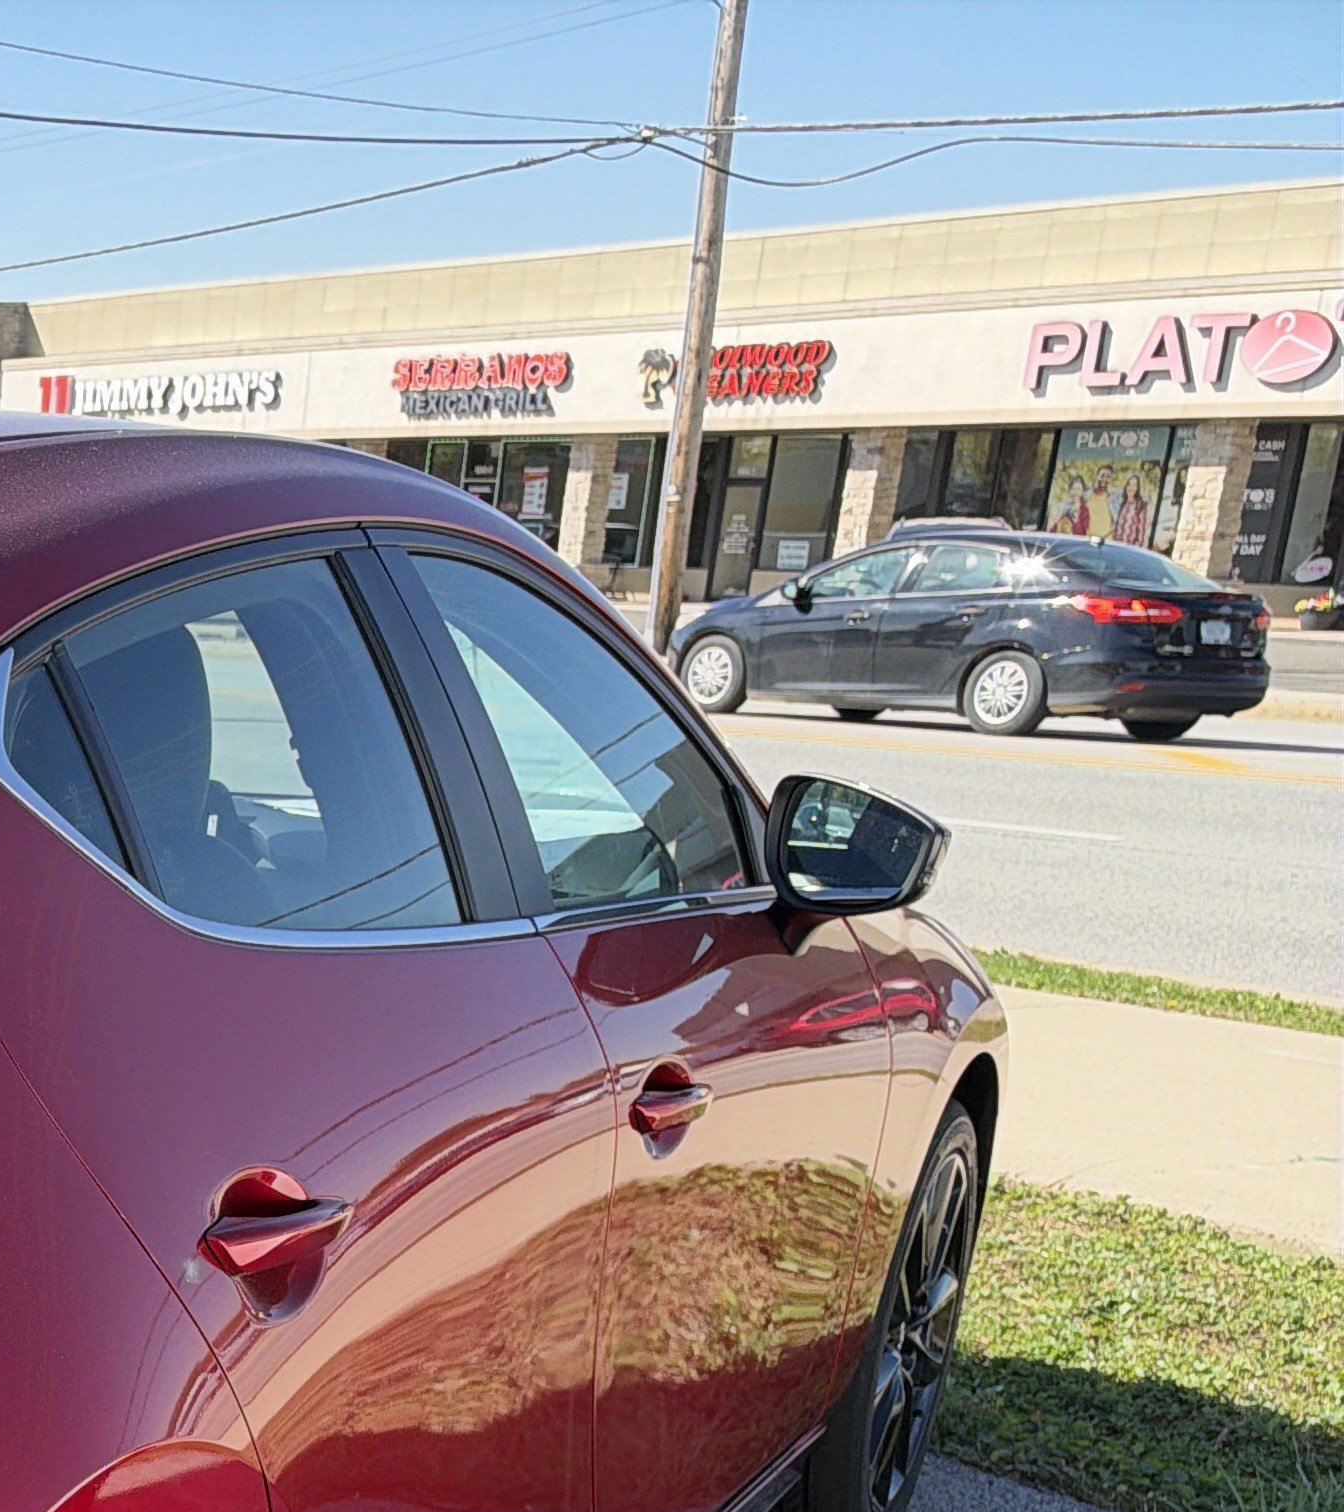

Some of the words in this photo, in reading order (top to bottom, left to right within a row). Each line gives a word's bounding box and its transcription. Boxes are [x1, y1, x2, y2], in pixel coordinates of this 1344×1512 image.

[72, 376, 169, 417] JIMMY
[167, 369, 278, 416] JOHN'S
[401, 389, 486, 415] MEXICAN
[489, 387, 550, 412] GRILL
